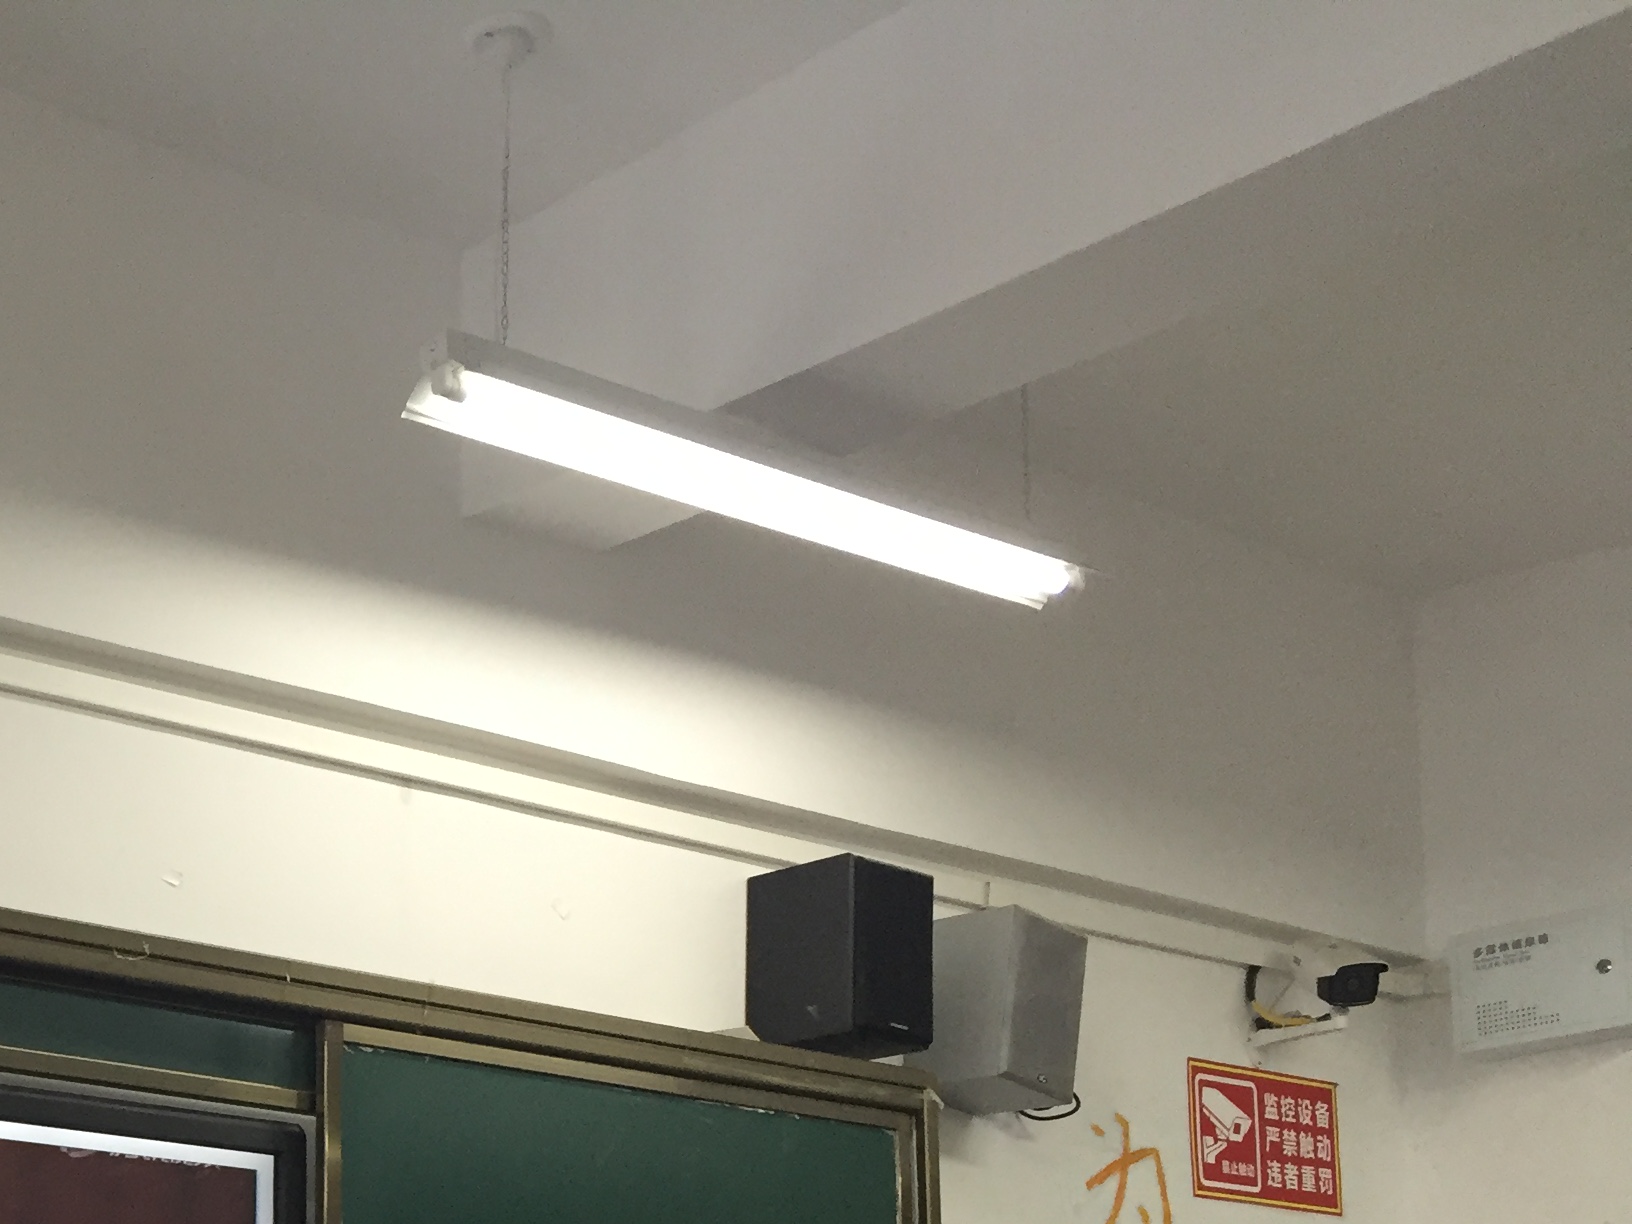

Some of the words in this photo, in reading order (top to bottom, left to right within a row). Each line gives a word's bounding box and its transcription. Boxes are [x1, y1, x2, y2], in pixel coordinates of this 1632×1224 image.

[1263, 1092, 1330, 1129] 监控设备
[1265, 1126, 1332, 1162] 严禁触动
[1266, 1159, 1334, 1195] 违者重罚
